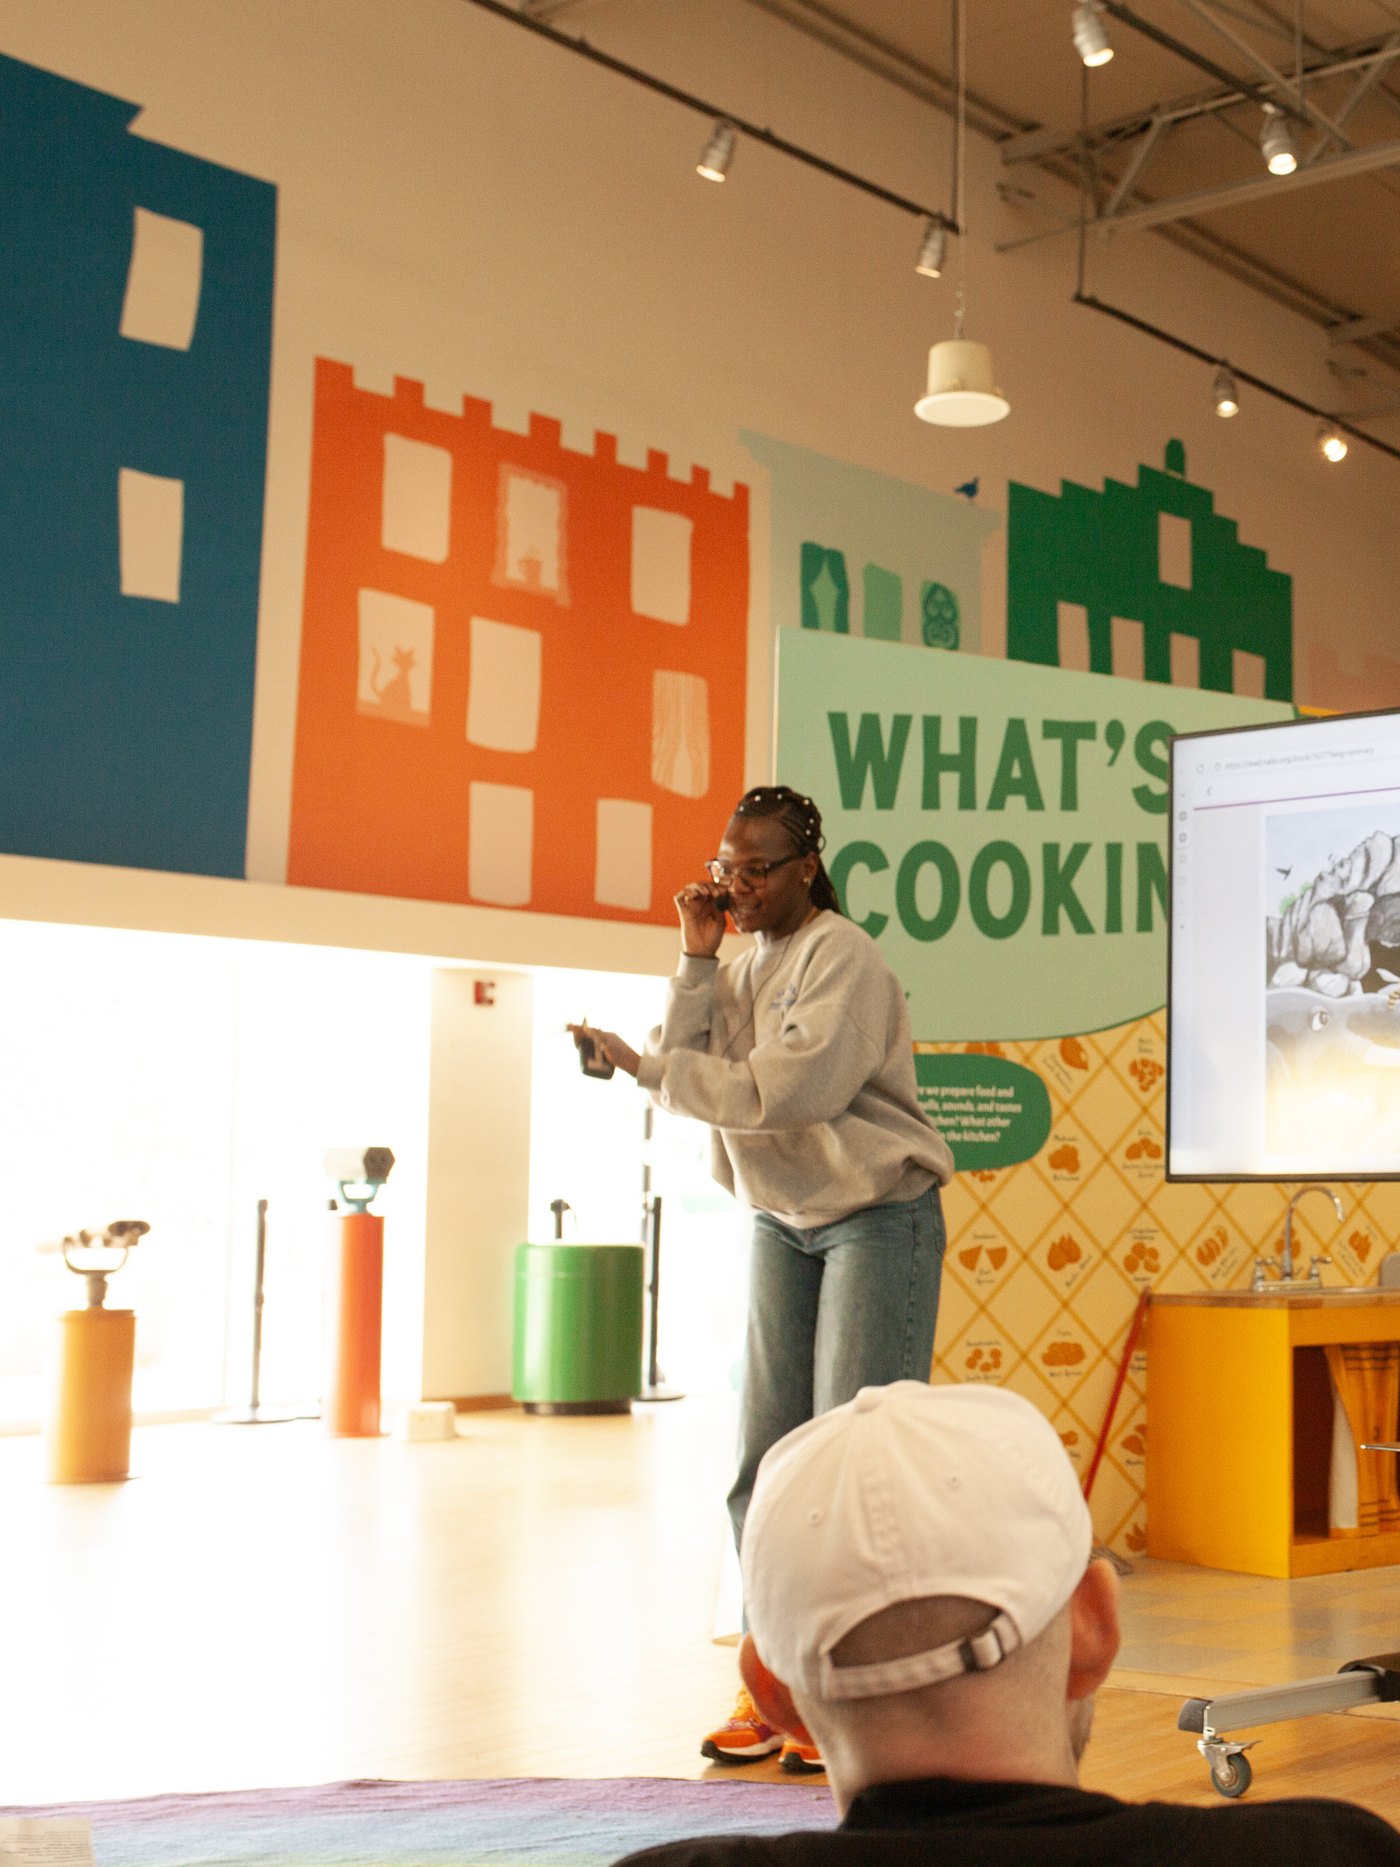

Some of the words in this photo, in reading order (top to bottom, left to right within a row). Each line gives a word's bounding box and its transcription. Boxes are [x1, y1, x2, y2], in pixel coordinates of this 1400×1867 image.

[925, 1086, 939, 1097] we
[940, 1086, 975, 1099] prepare
[976, 1084, 996, 1098] food
[998, 1085, 1015, 1098] and
[942, 1100, 975, 1113] sounds,
[977, 1100, 995, 1113] and
[995, 1102, 1022, 1114] tastes
[960, 1114, 985, 1128] What
[986, 1115, 1012, 1128] other
[946, 1130, 962, 1142] the
[962, 1129, 1001, 1143] kitchen?
